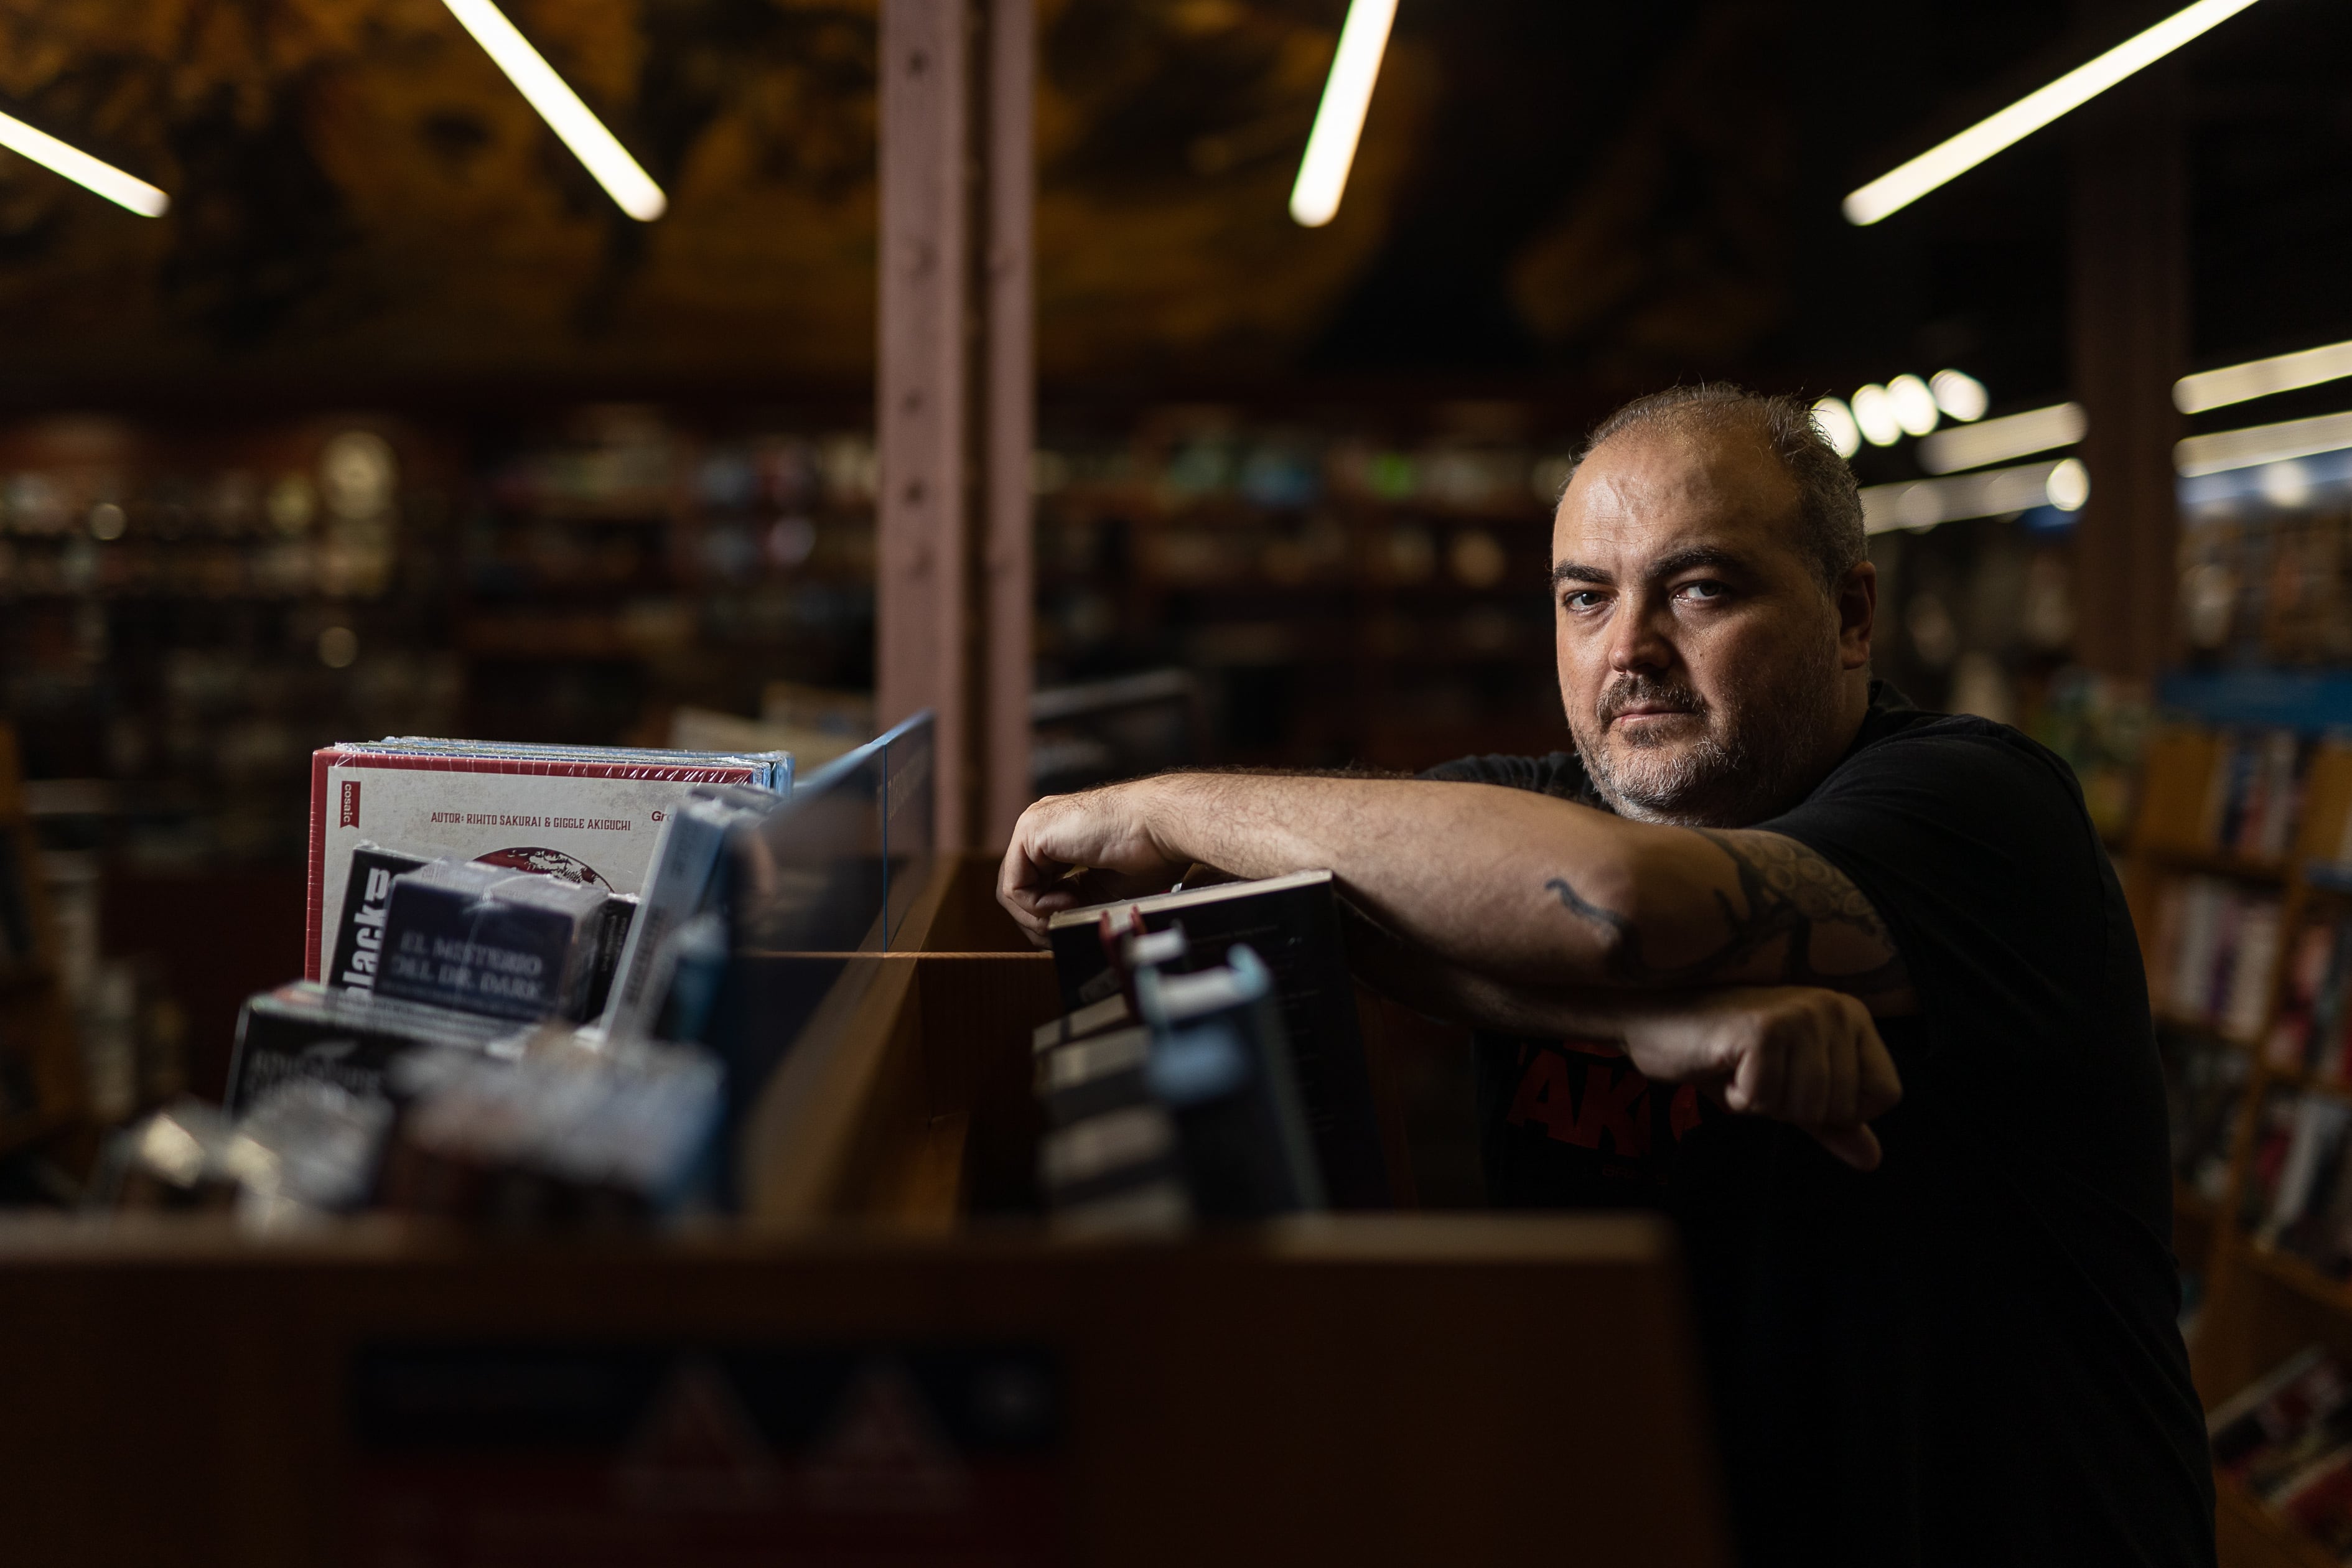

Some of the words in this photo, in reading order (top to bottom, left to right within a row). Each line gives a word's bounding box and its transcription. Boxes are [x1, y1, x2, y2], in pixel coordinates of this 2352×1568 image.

[431, 812, 464, 823] AUTOR:
[466, 813, 497, 825] RIHITO
[500, 815, 541, 827] SAKURAI
[544, 816, 551, 828] &
[553, 817, 585, 829] GIGGLE
[587, 819, 631, 831] AKIGUCHI
